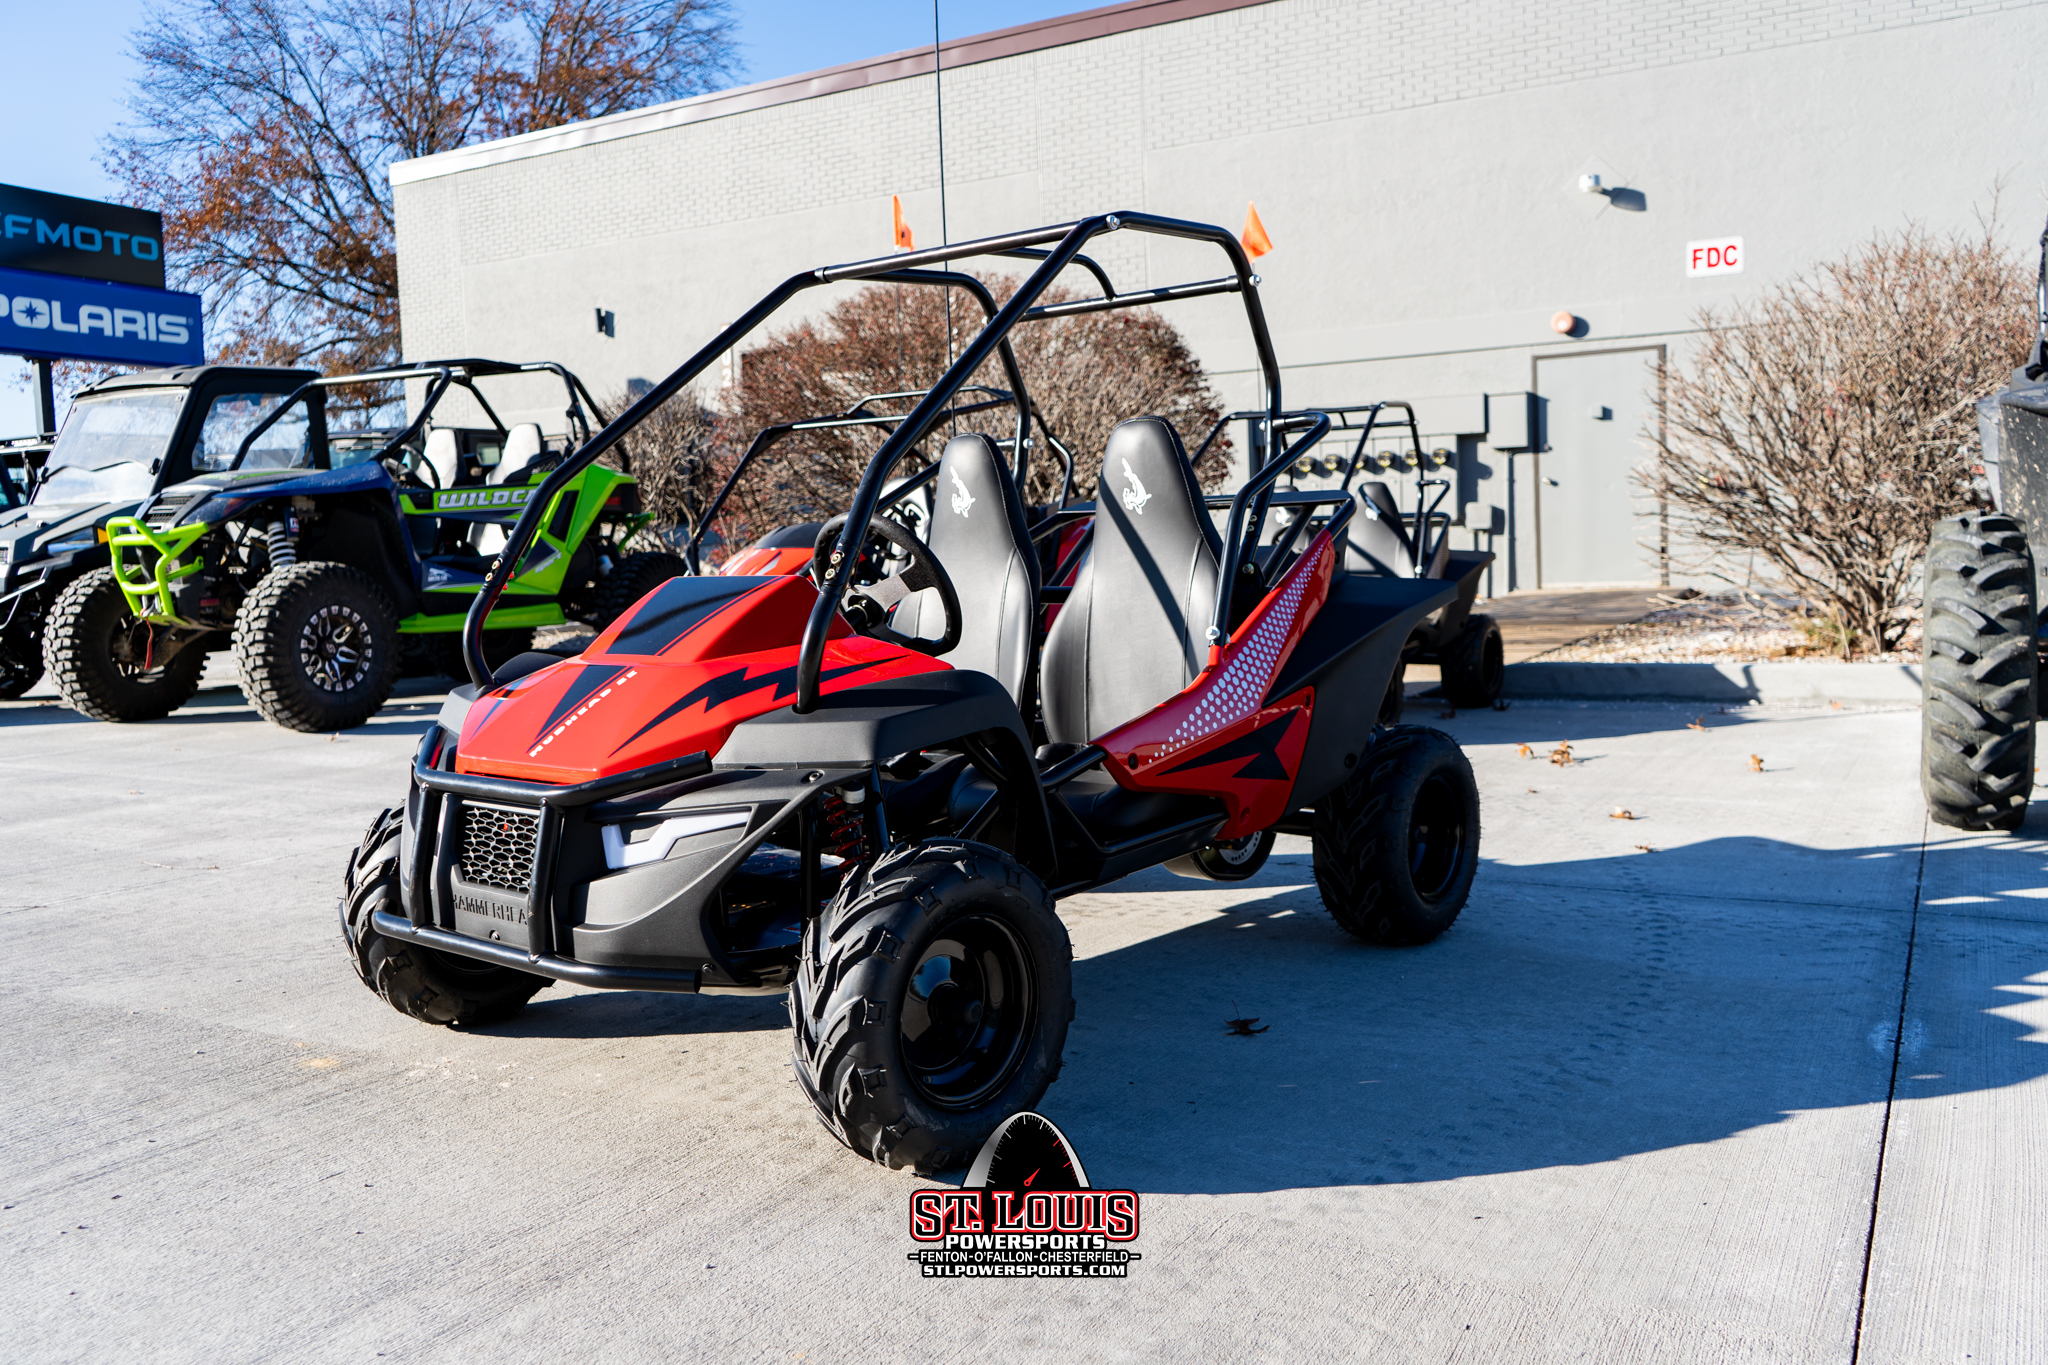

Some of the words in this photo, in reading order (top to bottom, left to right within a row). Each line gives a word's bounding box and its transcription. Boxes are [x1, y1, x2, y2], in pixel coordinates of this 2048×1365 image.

[0, 212, 160, 262] FMOTO
[1692, 245, 1738, 269] FDC
[438, 489, 537, 508] WILDC
[529, 688, 612, 758] MUDHEAD
[616, 669, 638, 686] SE
[453, 893, 528, 926] AMMERHEA
